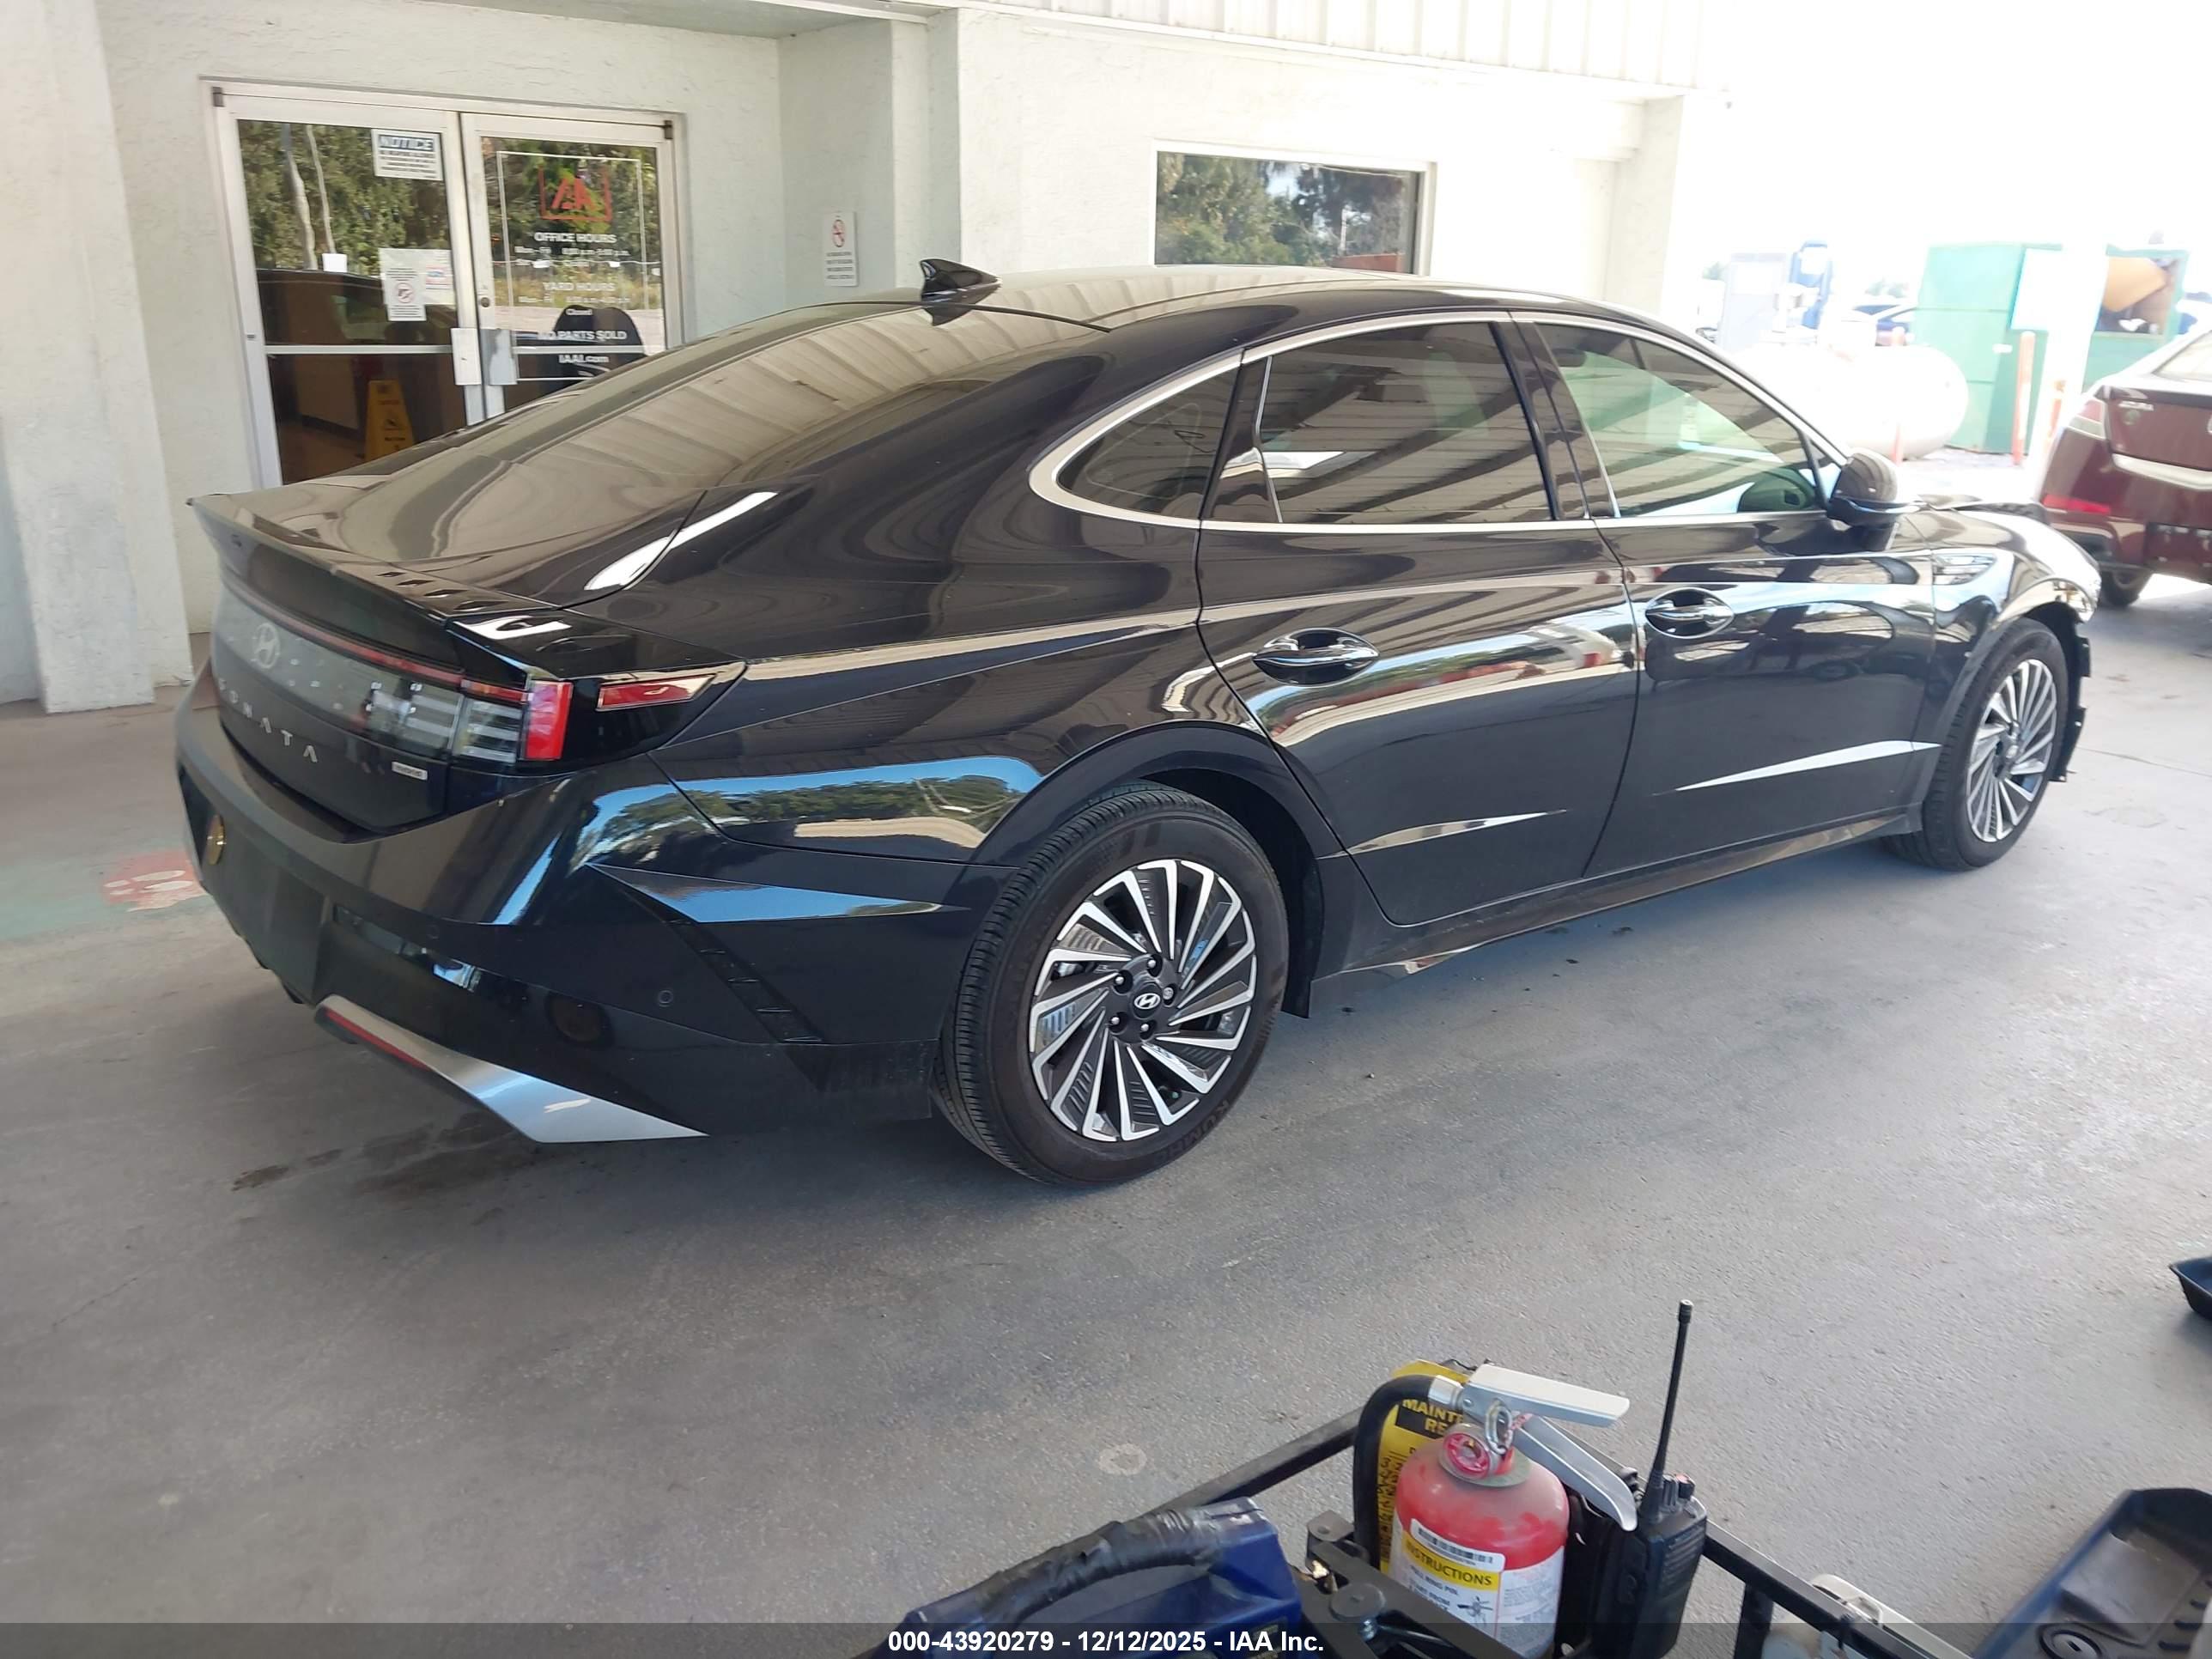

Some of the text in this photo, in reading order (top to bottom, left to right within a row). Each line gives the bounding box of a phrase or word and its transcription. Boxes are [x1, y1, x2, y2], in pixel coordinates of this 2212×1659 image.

[380, 135, 434, 151] NOTICE
[533, 232, 617, 243] OFFICE HOURS
[543, 282, 616, 291] YARD HOURS
[556, 330, 595, 340] PARTS
[595, 330, 628, 340] SOLD
[1405, 1538, 1492, 1586] INSTRUCTIONS
